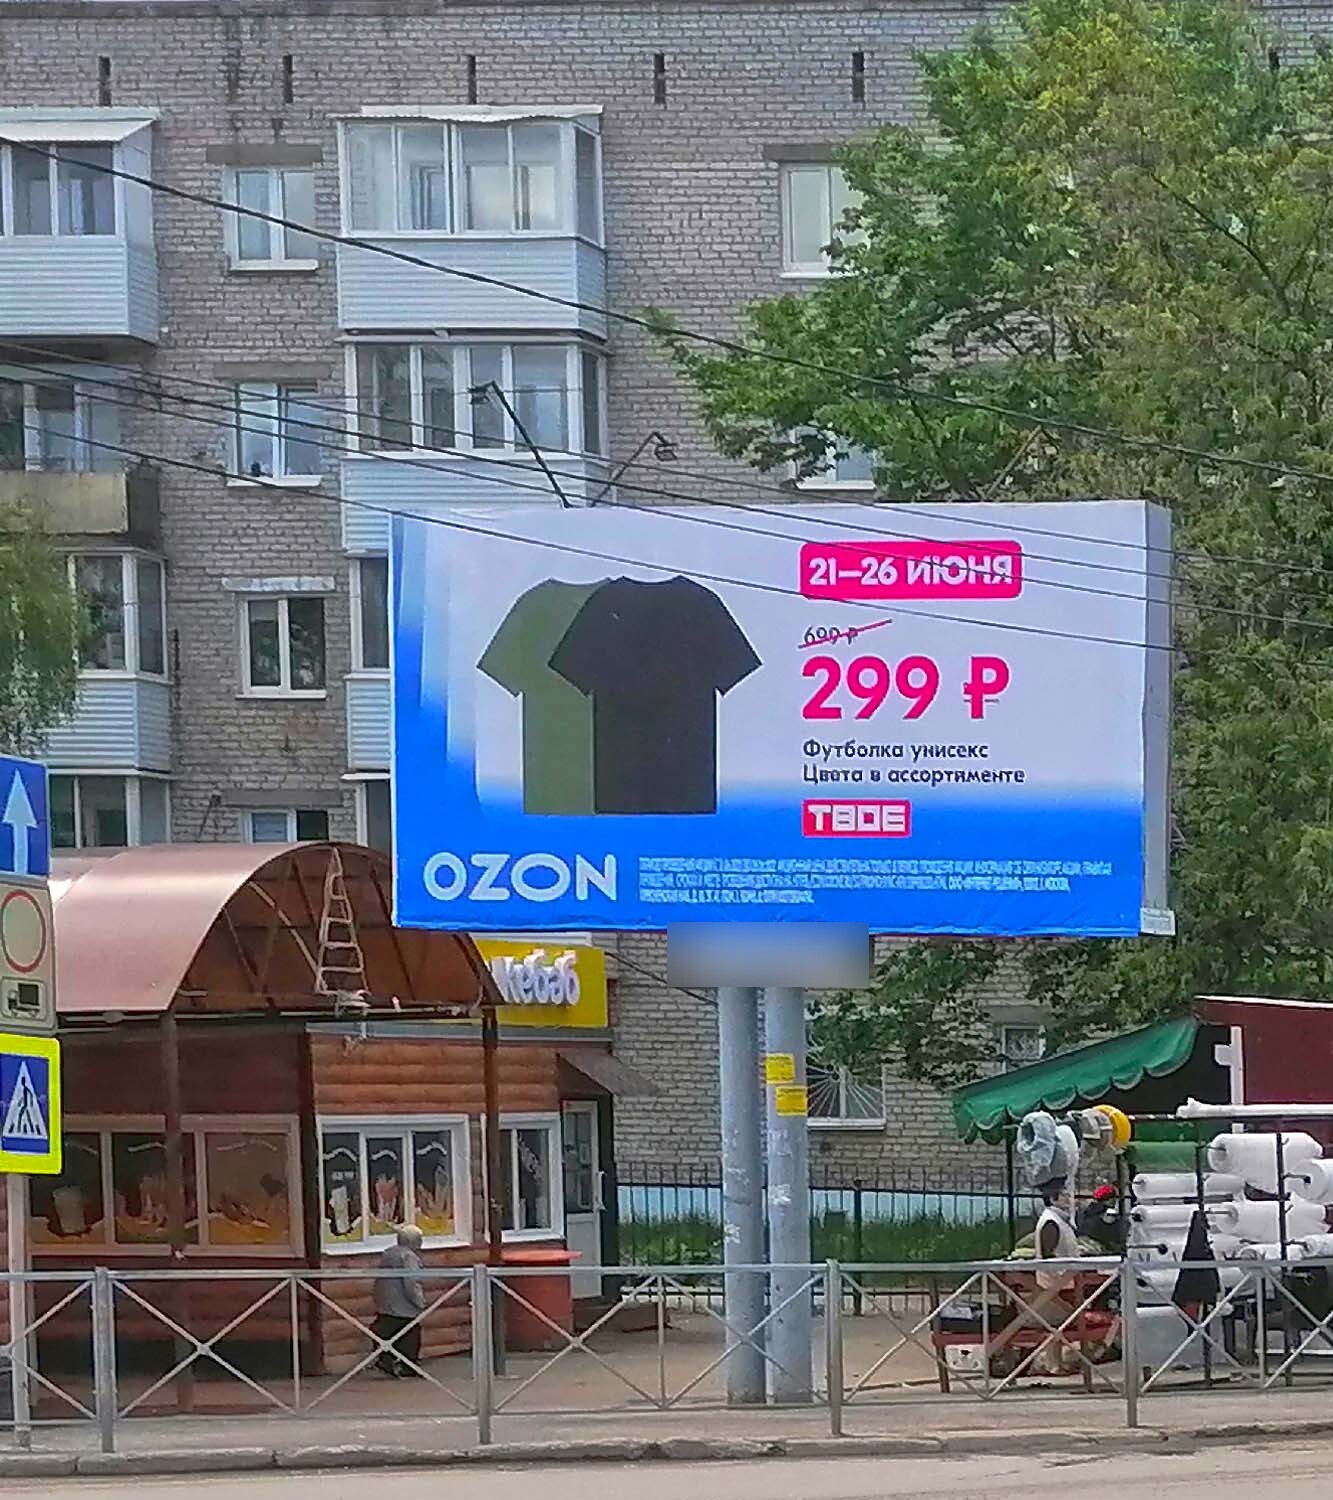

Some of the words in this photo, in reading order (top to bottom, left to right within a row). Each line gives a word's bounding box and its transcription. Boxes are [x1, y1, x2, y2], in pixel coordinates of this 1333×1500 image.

[907, 555, 1012, 584] ИЮНЯ
[803, 656, 939, 719] 299
[803, 739, 903, 761] Футболка
[911, 743, 988, 762] унисекс
[803, 765, 863, 784] Цвета
[870, 770, 881, 782] в
[888, 769, 1025, 787] ассортименте
[808, 804, 906, 832] ТВОЕ
[423, 852, 617, 902] OZON
